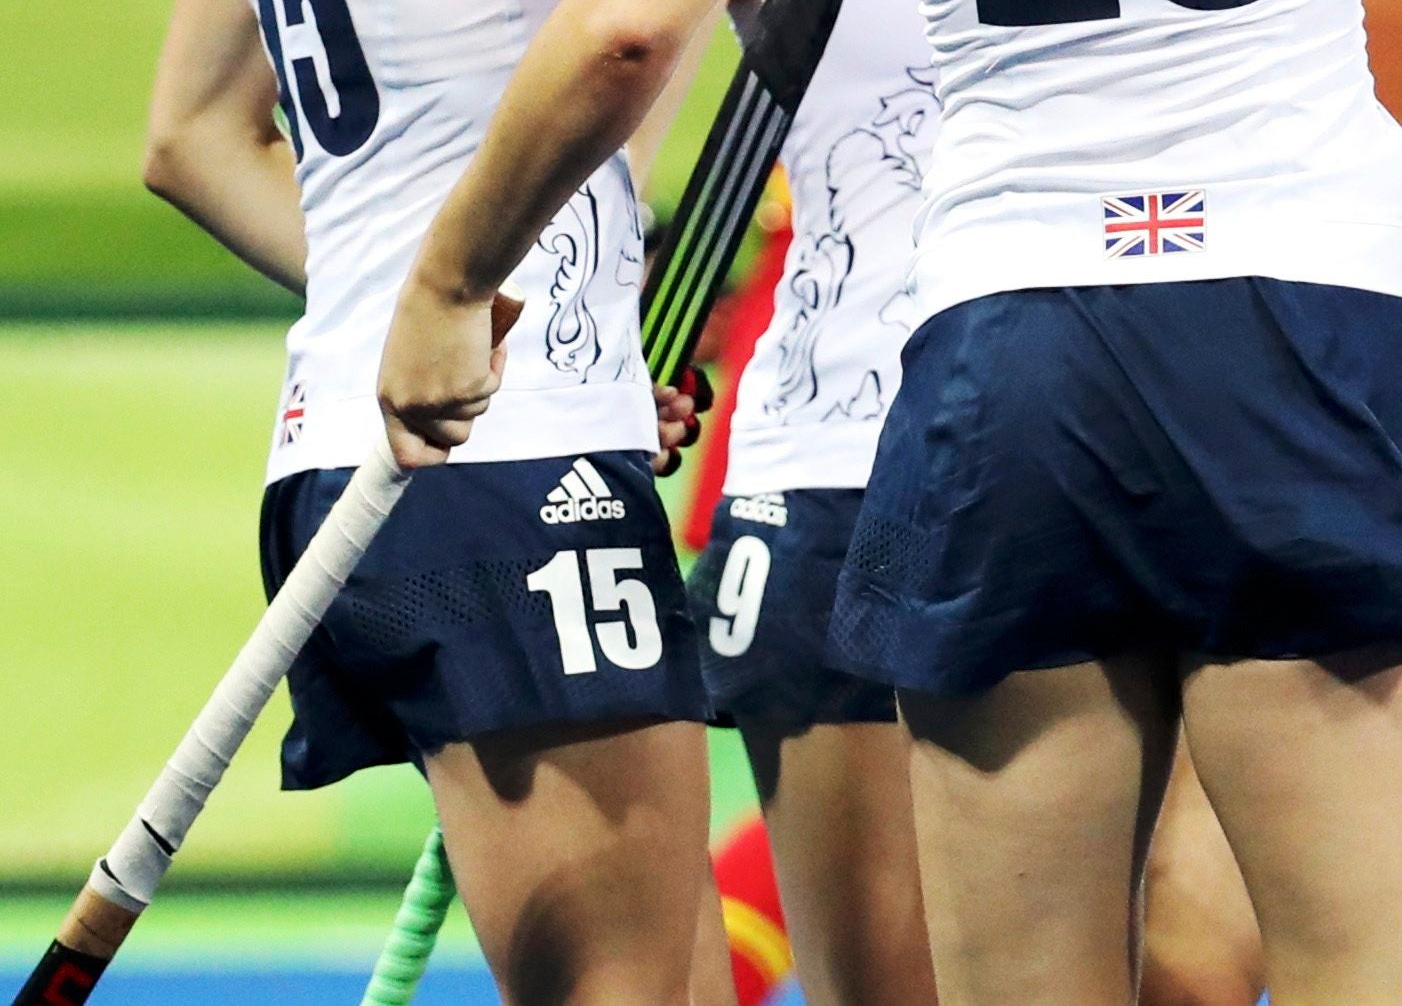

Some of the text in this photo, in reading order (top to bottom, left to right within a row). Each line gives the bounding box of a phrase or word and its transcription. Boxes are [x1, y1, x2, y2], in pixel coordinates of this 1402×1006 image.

[540, 499, 626, 524] adidas
[526, 547, 663, 675] 15
[709, 535, 771, 657] 9
